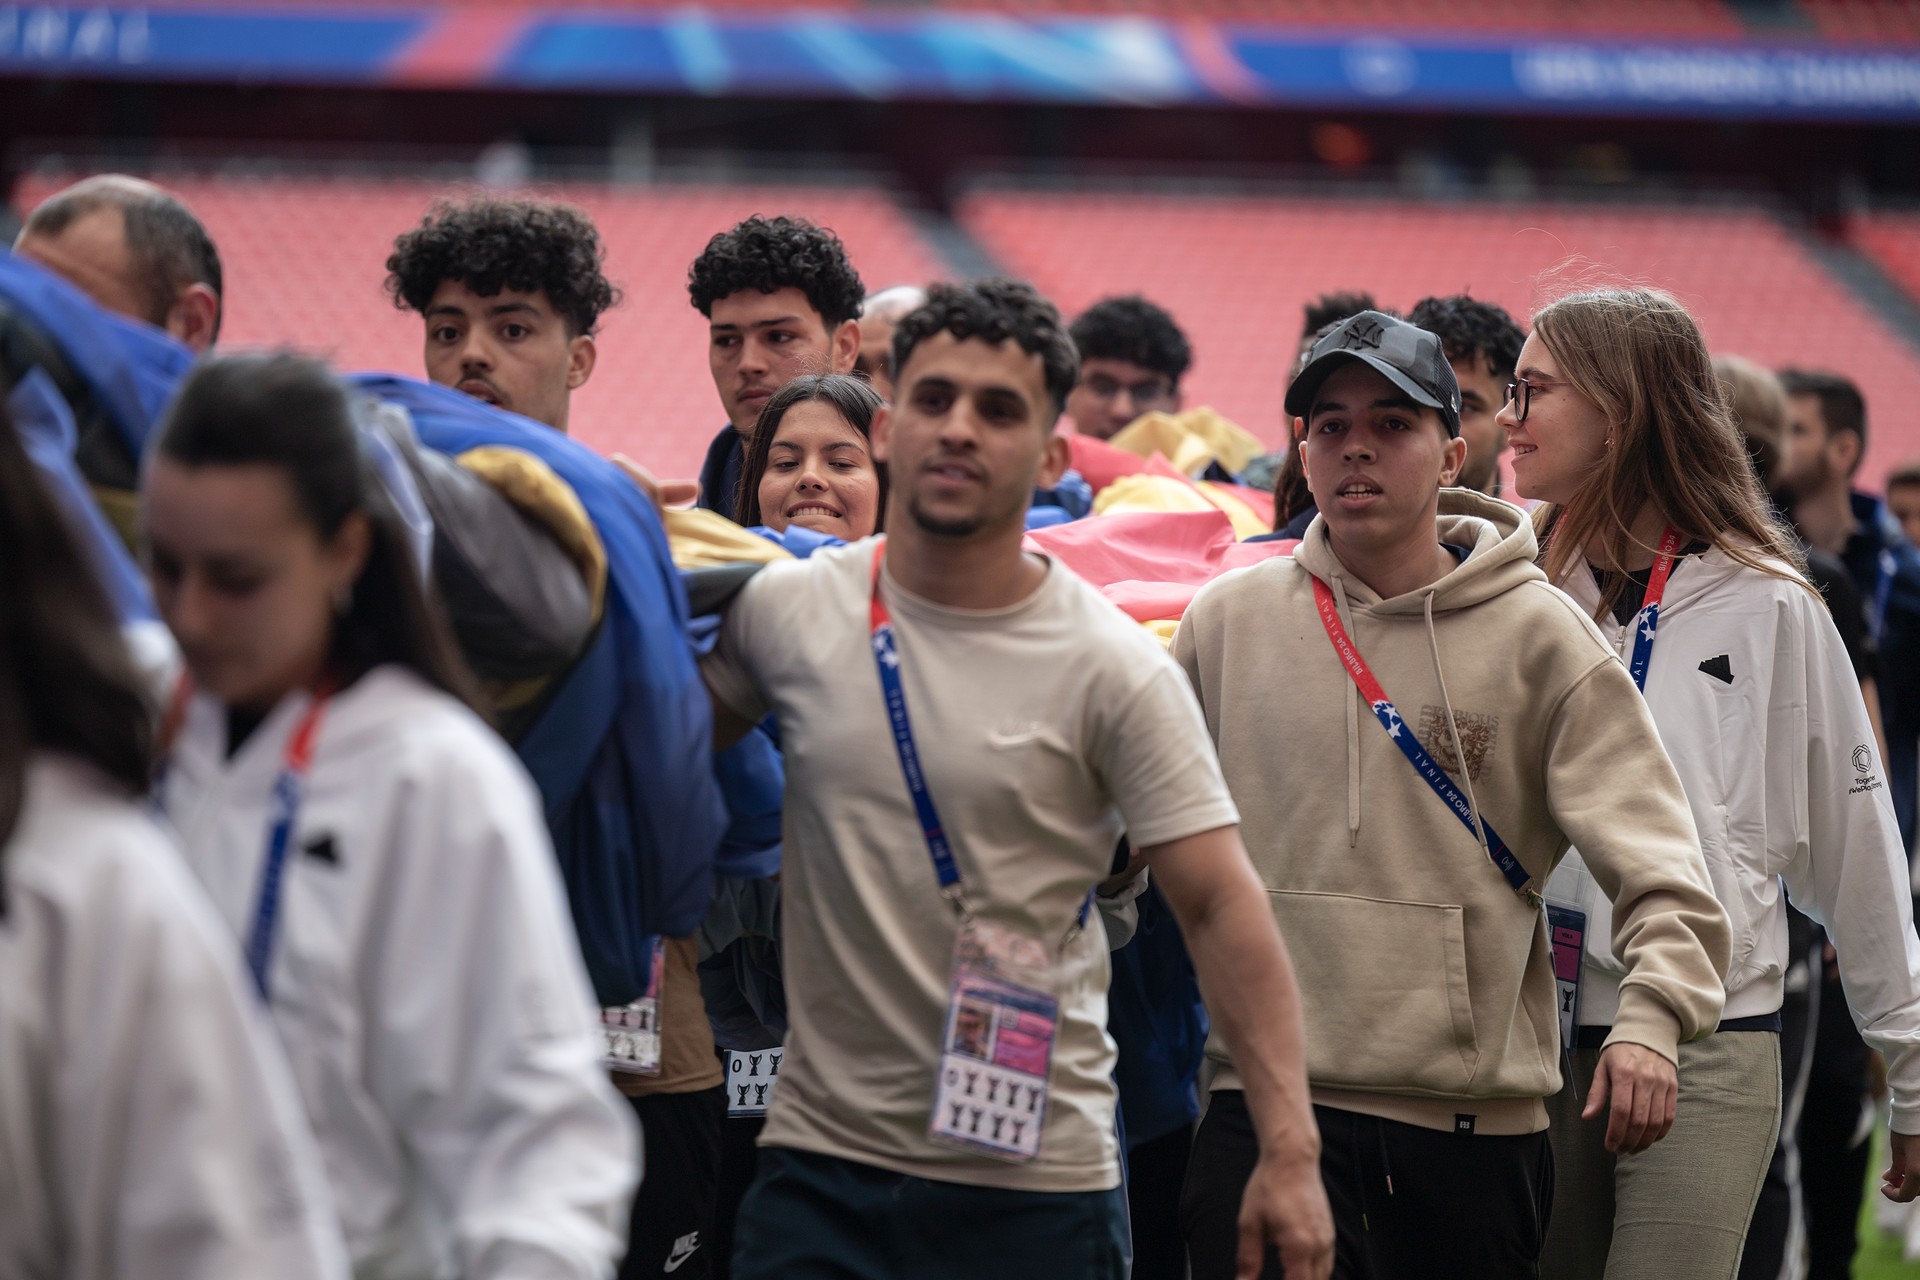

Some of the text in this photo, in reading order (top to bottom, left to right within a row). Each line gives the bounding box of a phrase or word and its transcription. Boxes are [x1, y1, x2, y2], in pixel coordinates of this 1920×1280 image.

[1321, 598, 1339, 636] FINAL
[1337, 637, 1347, 649] 24
[1415, 751, 1448, 790] FINAL
[1446, 789, 1458, 802] 24
[671, 1230, 699, 1257] NIKE
